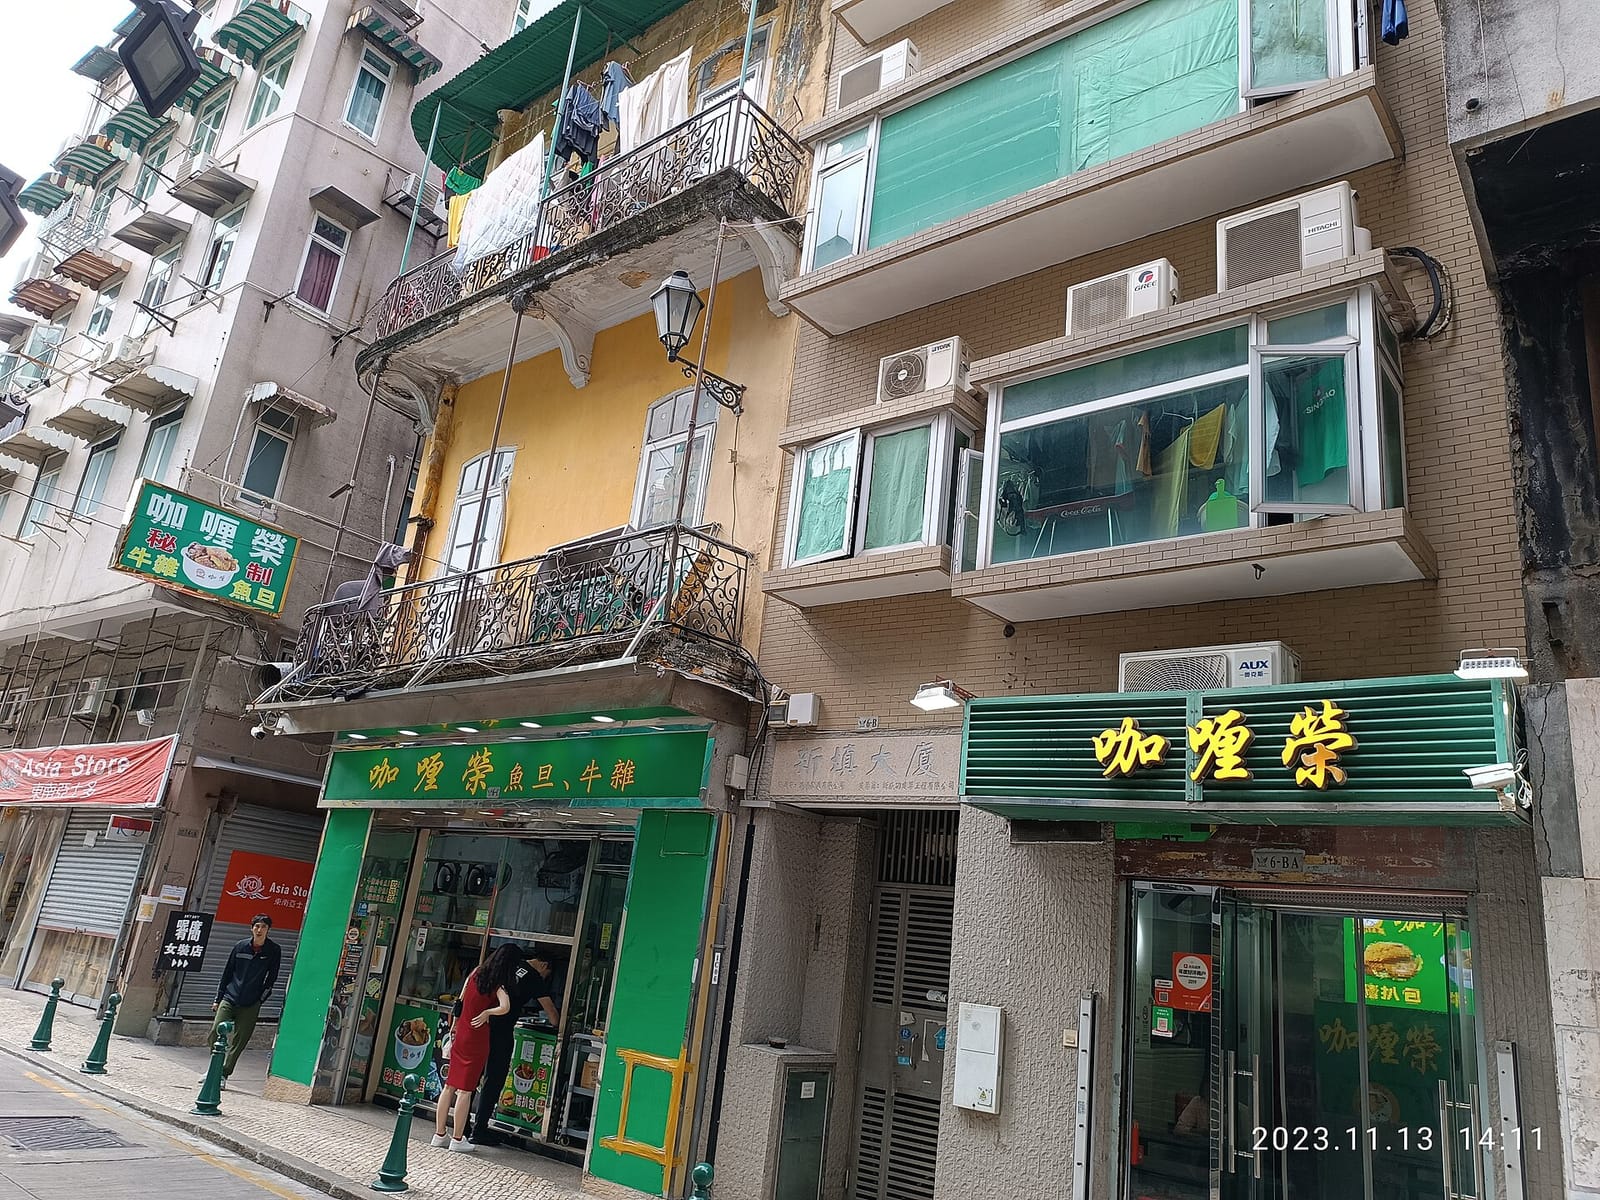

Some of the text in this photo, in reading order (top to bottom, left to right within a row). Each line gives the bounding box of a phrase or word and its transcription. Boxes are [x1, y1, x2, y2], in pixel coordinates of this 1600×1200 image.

[1308, 221, 1337, 233] HITACHI
[1134, 280, 1158, 291] GREE
[146, 493, 288, 567] 咖喱榮
[146, 527, 274, 586] 秘 制
[127, 546, 276, 610] 牛雜 魚旦
[1239, 660, 1269, 670] AUX
[1091, 699, 1356, 790] 咖喱榮
[20, 753, 130, 778] Asia Store
[368, 746, 637, 796] 咖喱榮 魚旦、牛雜
[1270, 857, 1299, 870] 6-BA
[269, 882, 308, 897] Asia Sto
[274, 898, 304, 909] 東南亞士
[163, 942, 205, 957] 女裝店
